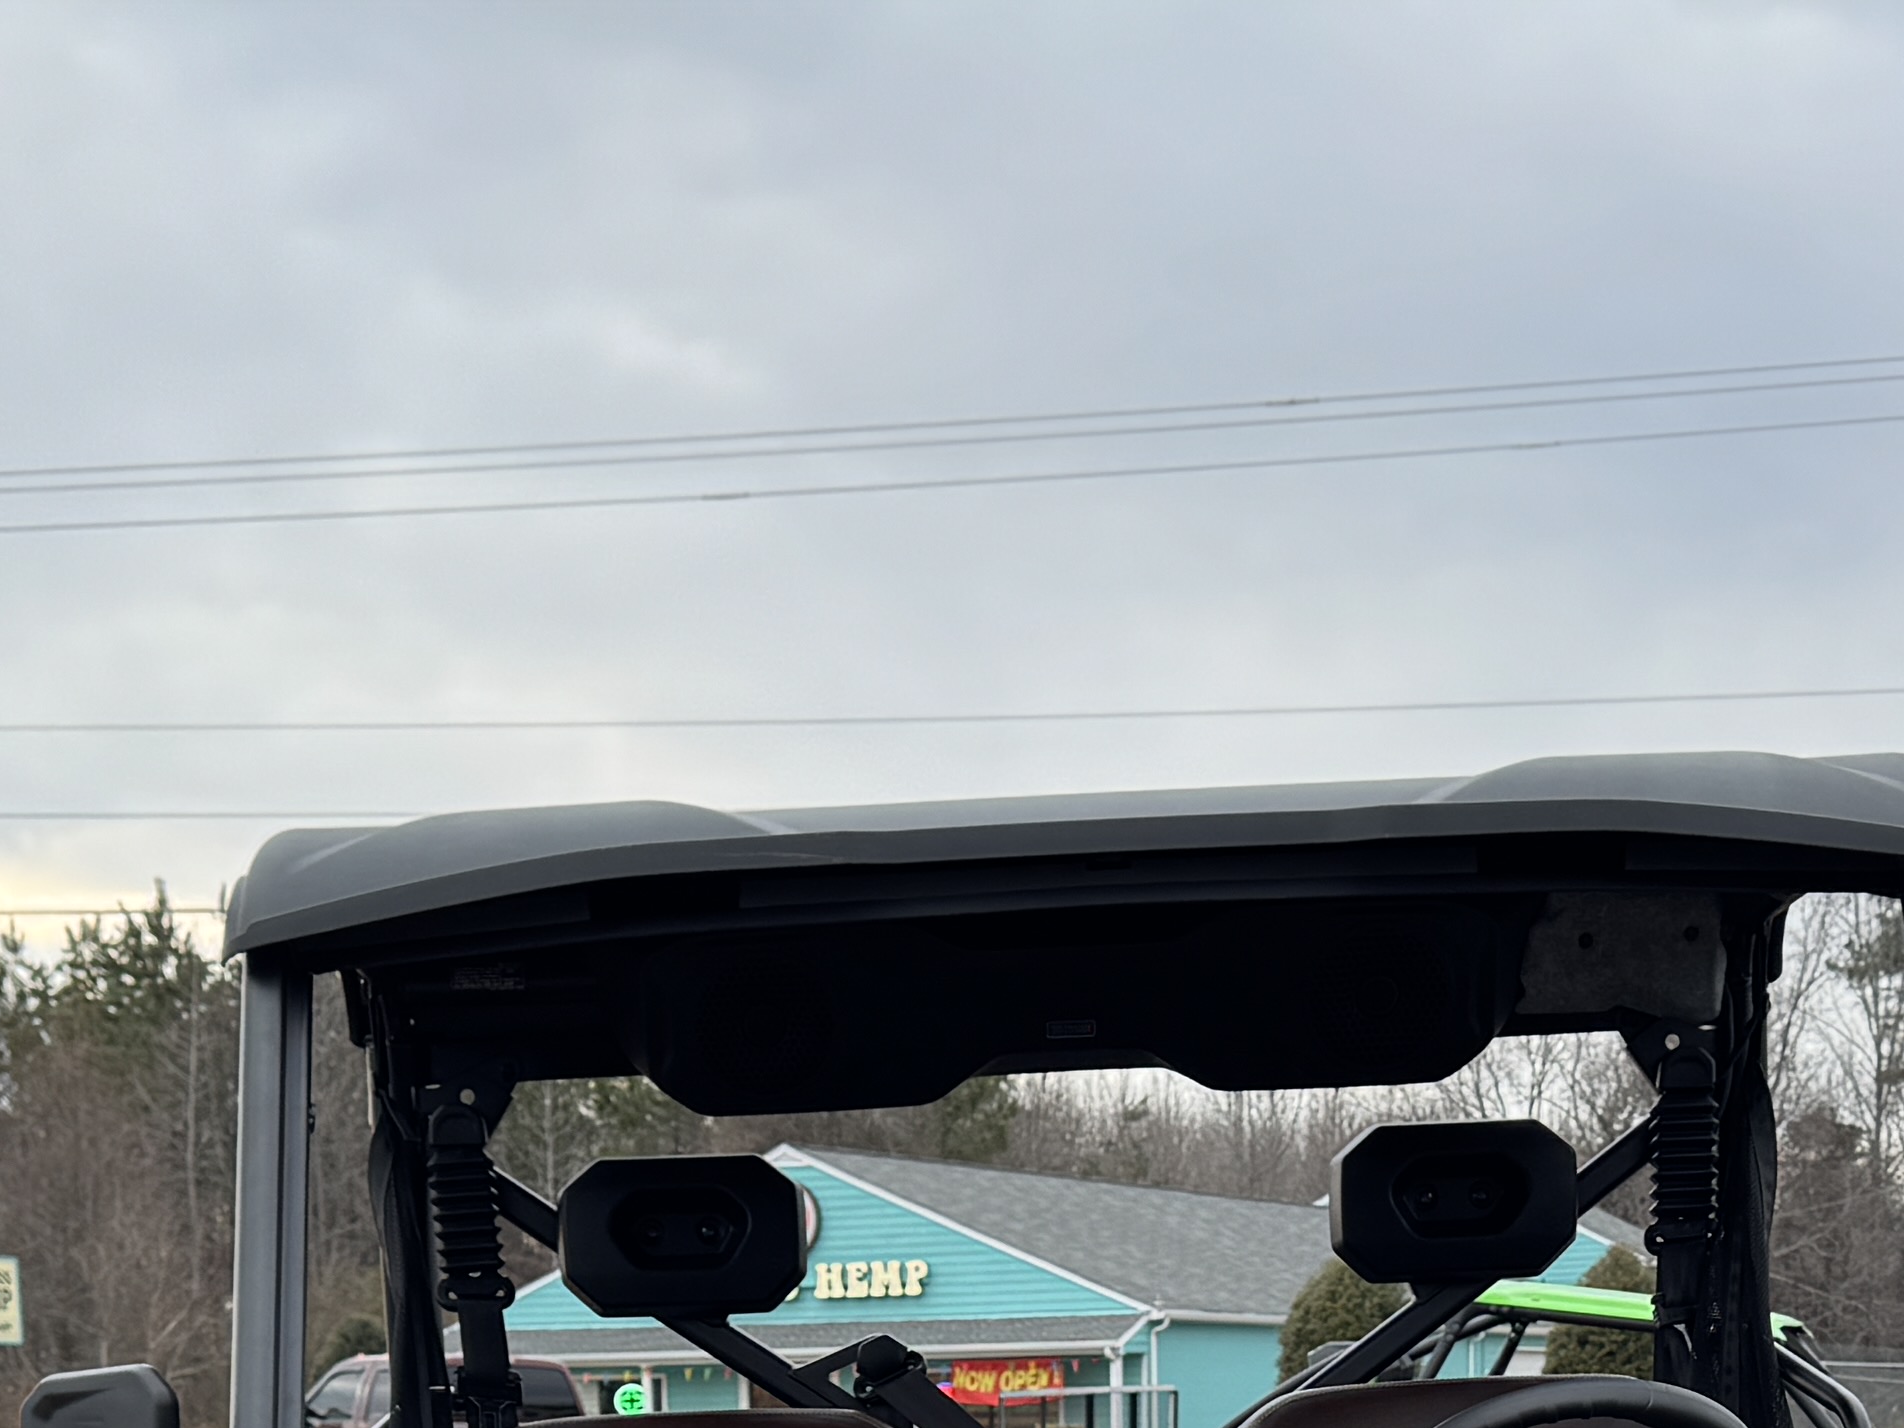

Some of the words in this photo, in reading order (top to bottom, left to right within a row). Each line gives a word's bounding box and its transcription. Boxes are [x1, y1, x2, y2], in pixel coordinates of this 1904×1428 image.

[813, 1259, 929, 1300] HEMP
[952, 1365, 996, 1394] NOW
[999, 1366, 1050, 1392] OPEN
